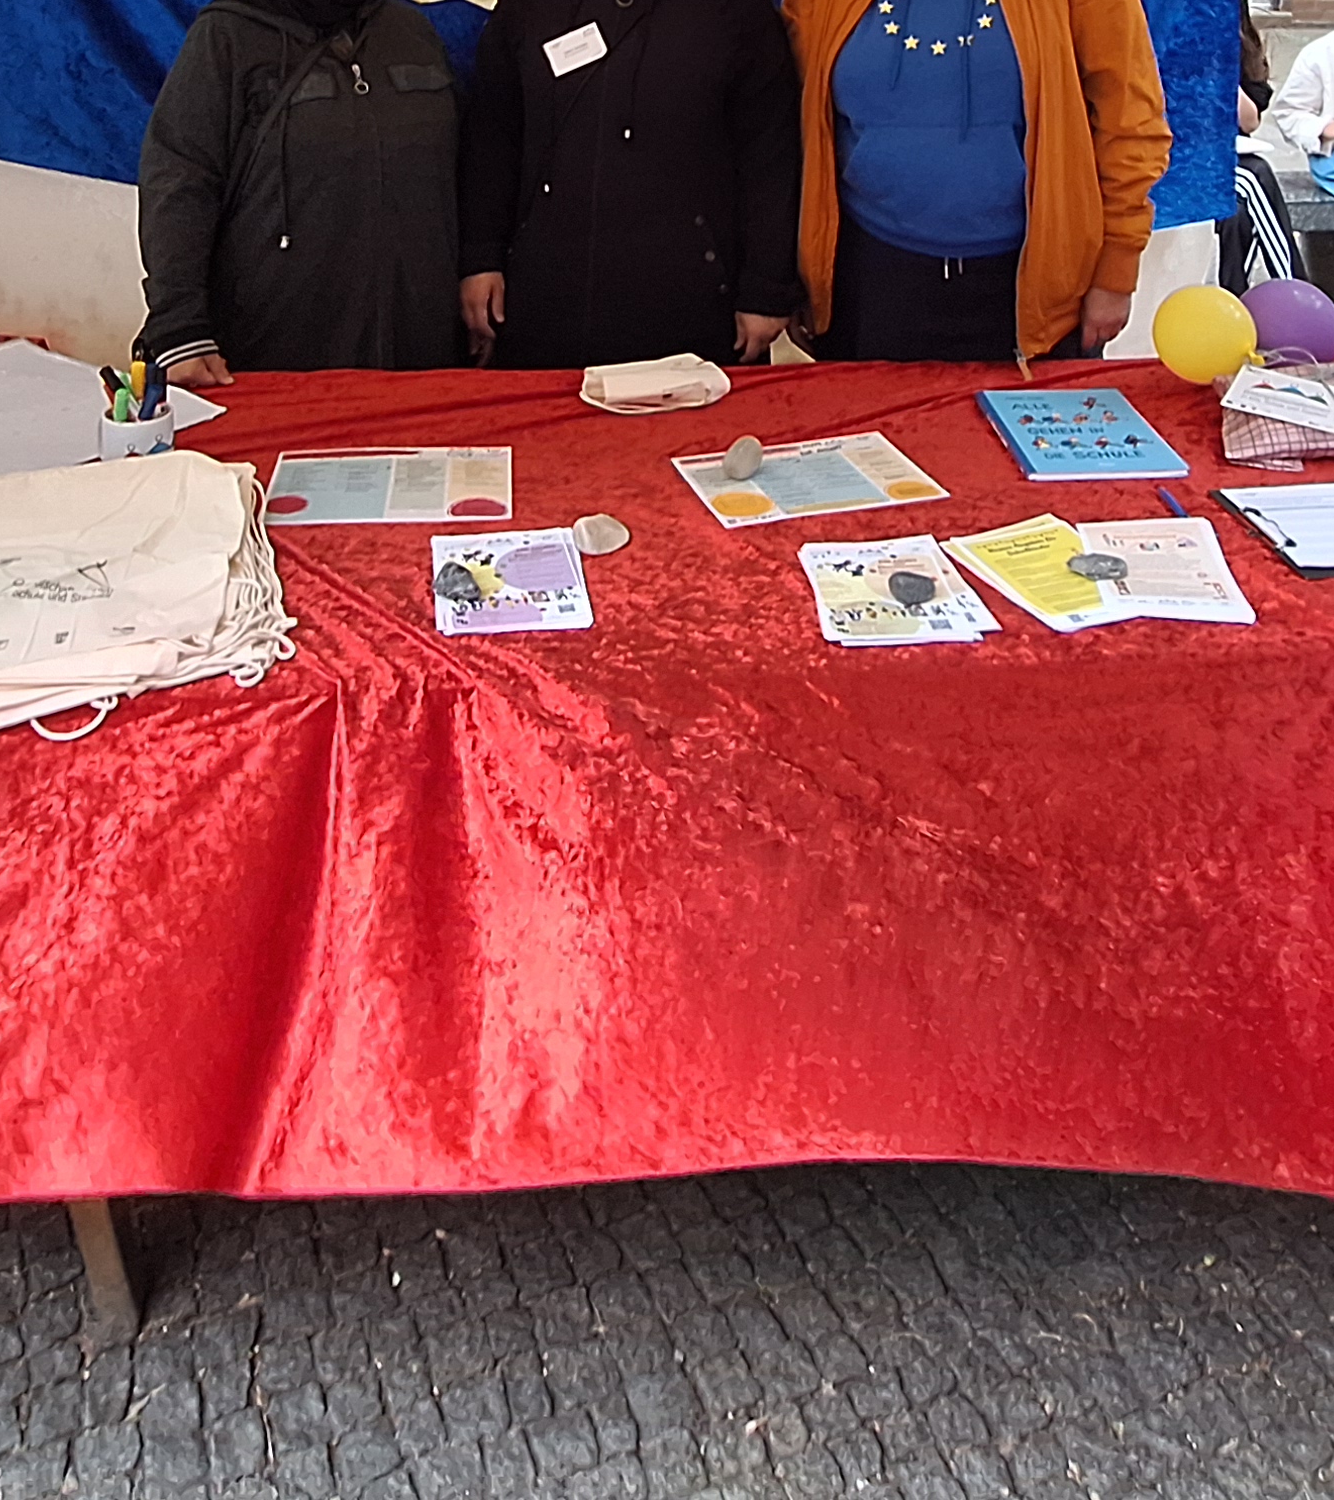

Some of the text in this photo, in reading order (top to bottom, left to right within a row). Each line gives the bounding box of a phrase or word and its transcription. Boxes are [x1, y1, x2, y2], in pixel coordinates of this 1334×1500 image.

[1011, 402, 1054, 411] ALLE
[1027, 426, 1105, 435] GEHEN IN
[1043, 450, 1147, 460] DIE SCHULE
